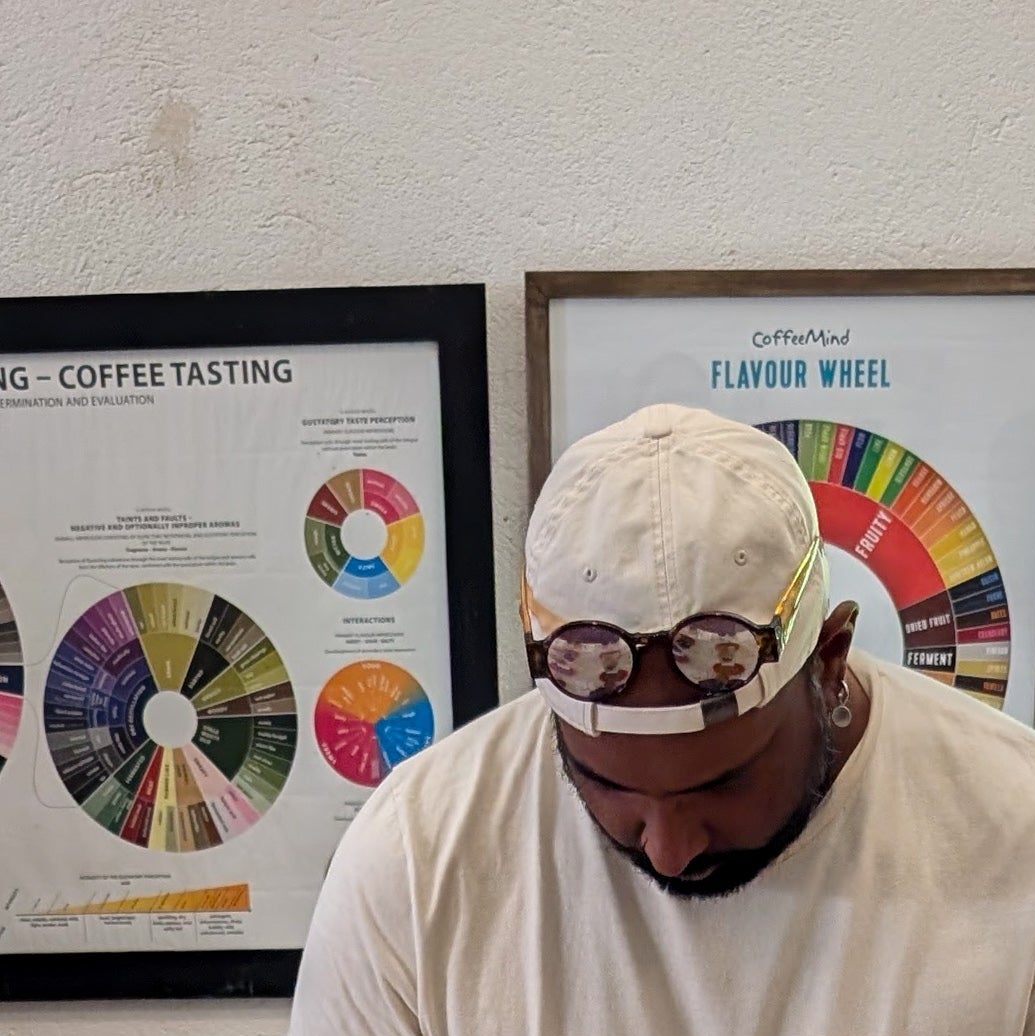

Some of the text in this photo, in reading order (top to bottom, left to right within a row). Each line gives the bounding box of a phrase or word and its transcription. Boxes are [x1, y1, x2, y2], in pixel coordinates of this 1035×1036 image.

[752, 329, 851, 349] CoffeeMind
[58, 362, 165, 390] COFFEE
[170, 359, 293, 387] TASTING
[711, 359, 890, 389] FLAVOUR WHEEL
[66, 396, 89, 407] AND
[91, 394, 155, 406] EVALUATION
[855, 509, 892, 559] FRUITY
[343, 616, 395, 624] INTERACTIONS
[905, 614, 951, 634] DRIED FRUIT
[907, 652, 953, 666] FERMENT
